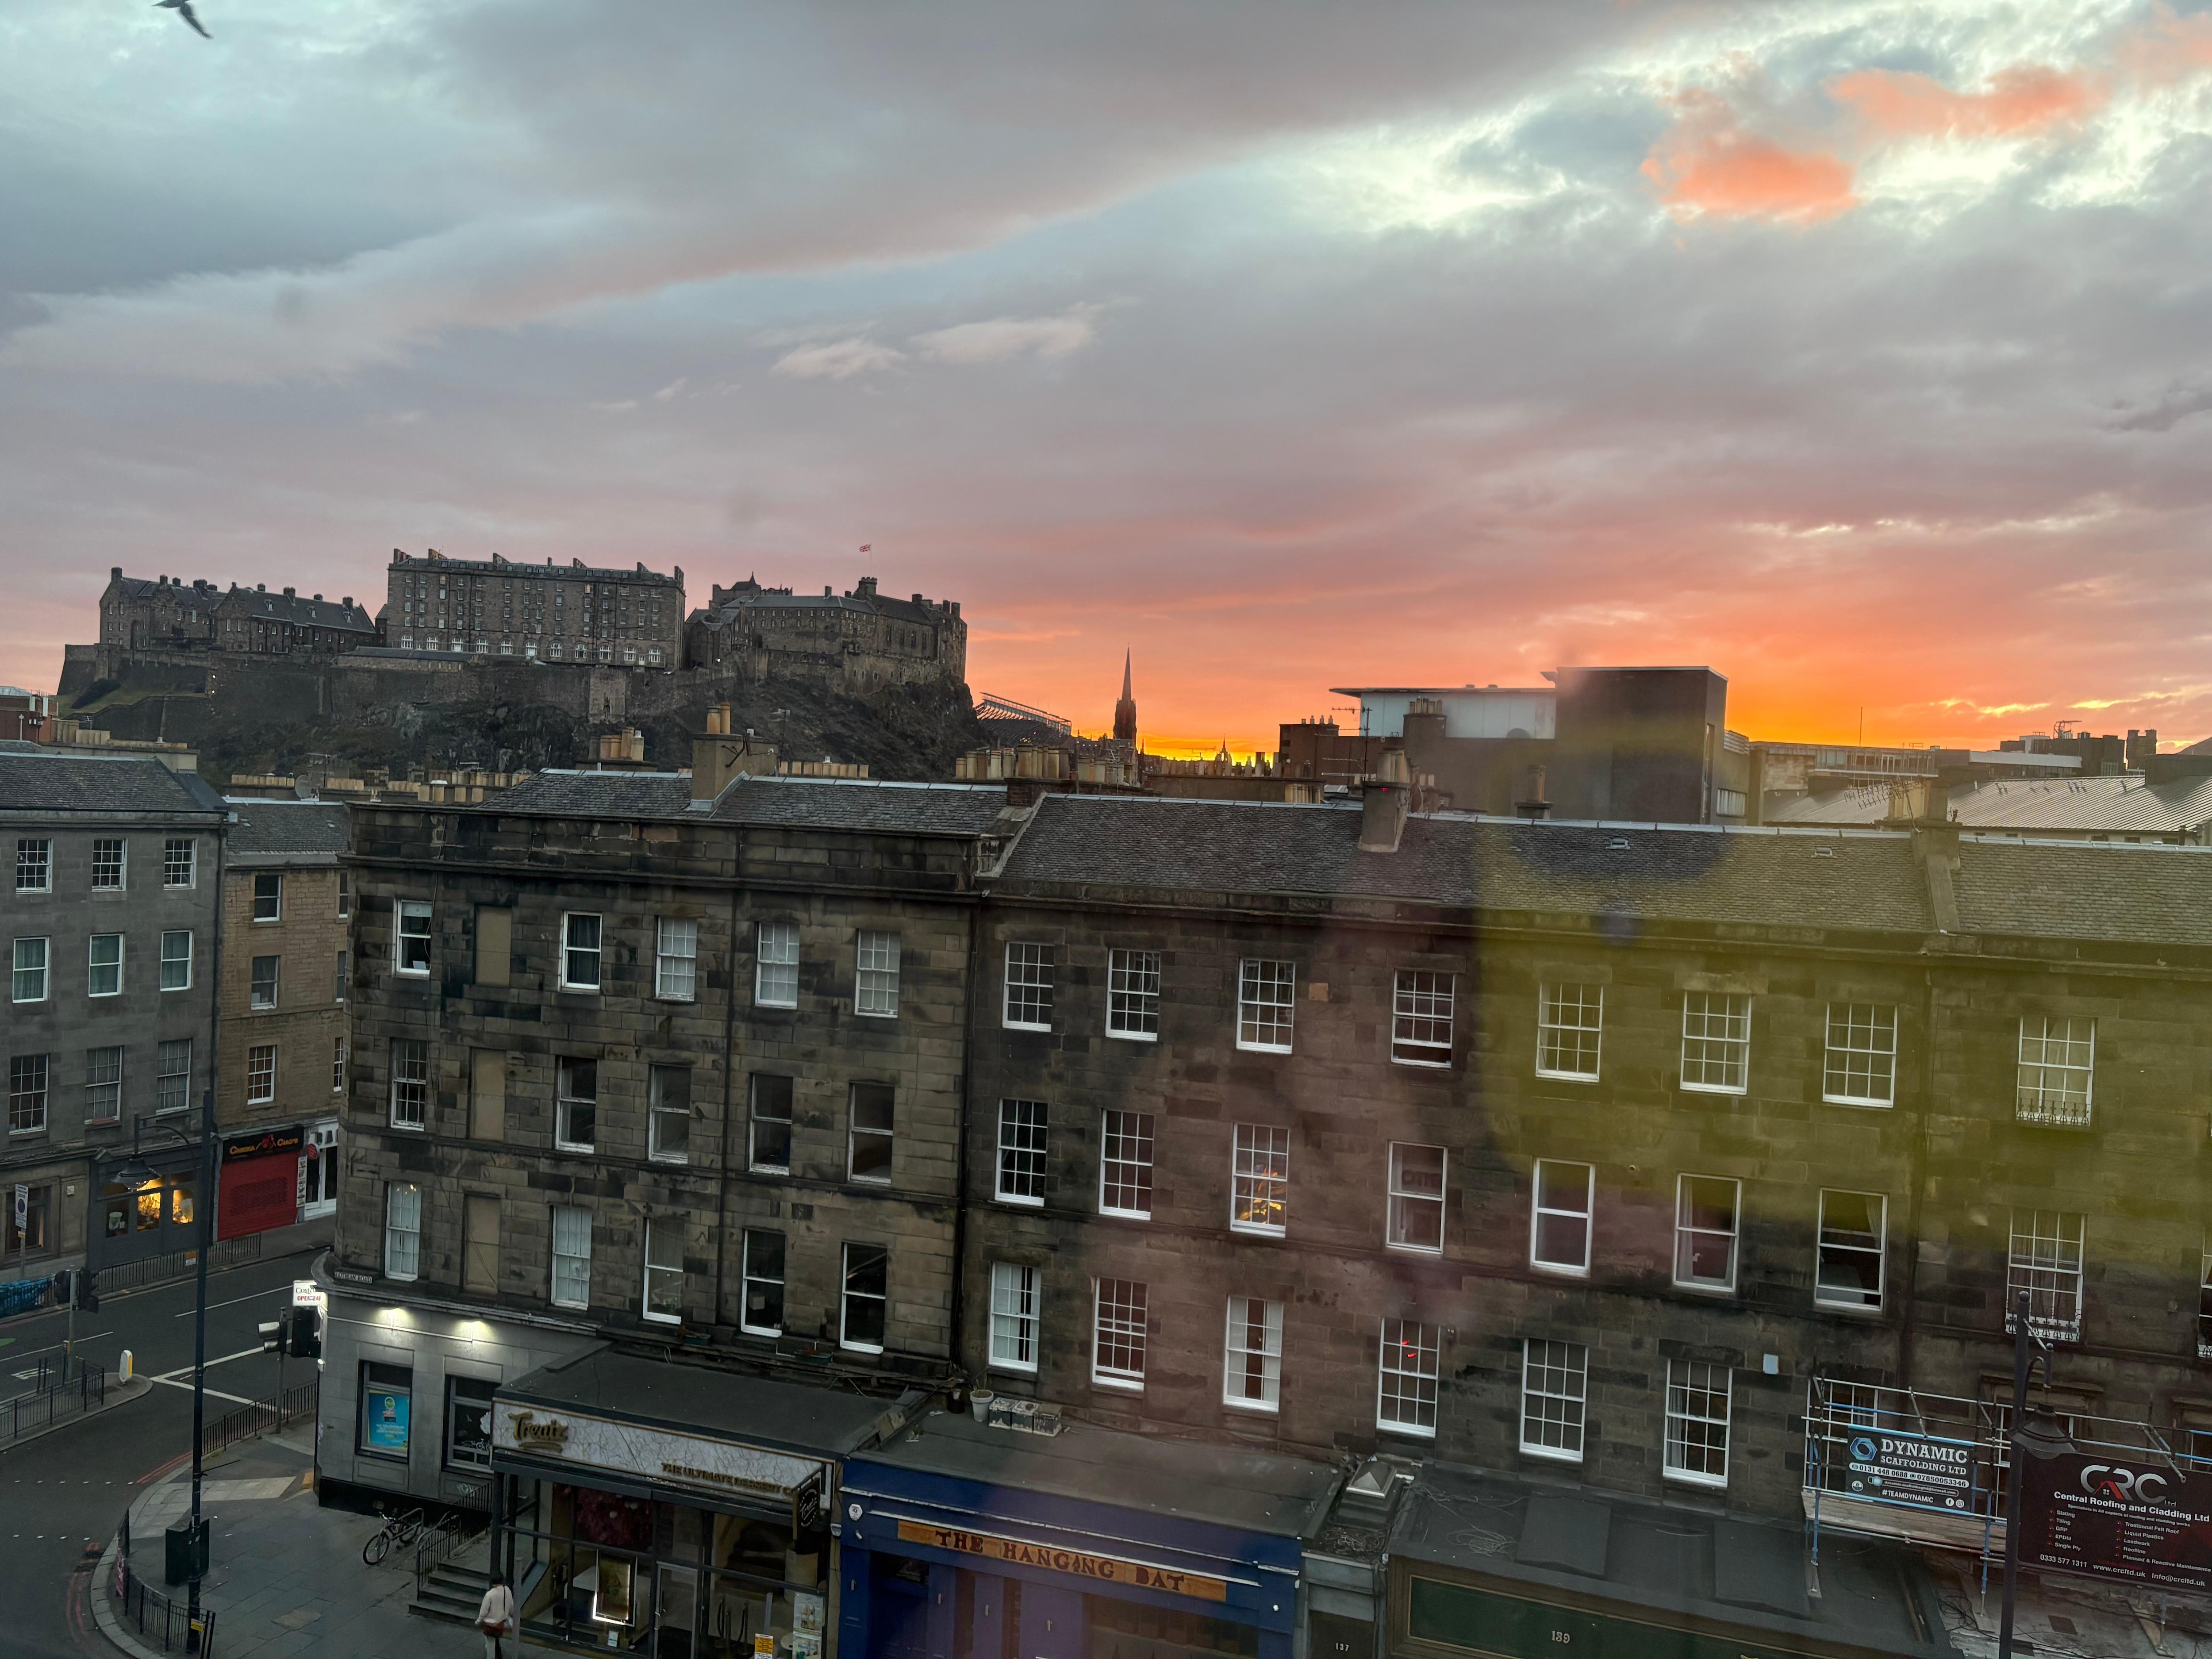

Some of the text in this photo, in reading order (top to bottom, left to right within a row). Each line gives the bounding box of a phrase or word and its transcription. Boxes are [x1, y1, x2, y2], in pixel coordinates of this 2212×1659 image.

[508, 1412, 568, 1441] Treatz
[1881, 1439, 1968, 1463] DYNAMIC
[1881, 1455, 1967, 1475] SCAFFOLDING LTD
[661, 1463, 682, 1475] THE
[683, 1467, 733, 1485] ULTIMATE
[734, 1477, 780, 1493] DESSERT
[1917, 1475, 1966, 1487] 07850053346
[2080, 1465, 2168, 1503] CRC
[1882, 1489, 1934, 1503] #TEAMDYNAMIC
[2054, 1491, 2087, 1503] Central
[2090, 1497, 2126, 1511] Roofing
[2149, 1506, 2192, 1521] Cladding
[2125, 1522, 2153, 1530] Traditional
[936, 1531, 1184, 1591] THE HANGING BAT
[2040, 1554, 2056, 1563] 0333
[2093, 1564, 2146, 1577] www.crcltd.uk
[2177, 1563, 2212, 1572] Maintenance
[1336, 1643, 1349, 1651] 137
[1551, 1630, 1571, 1644] 139
